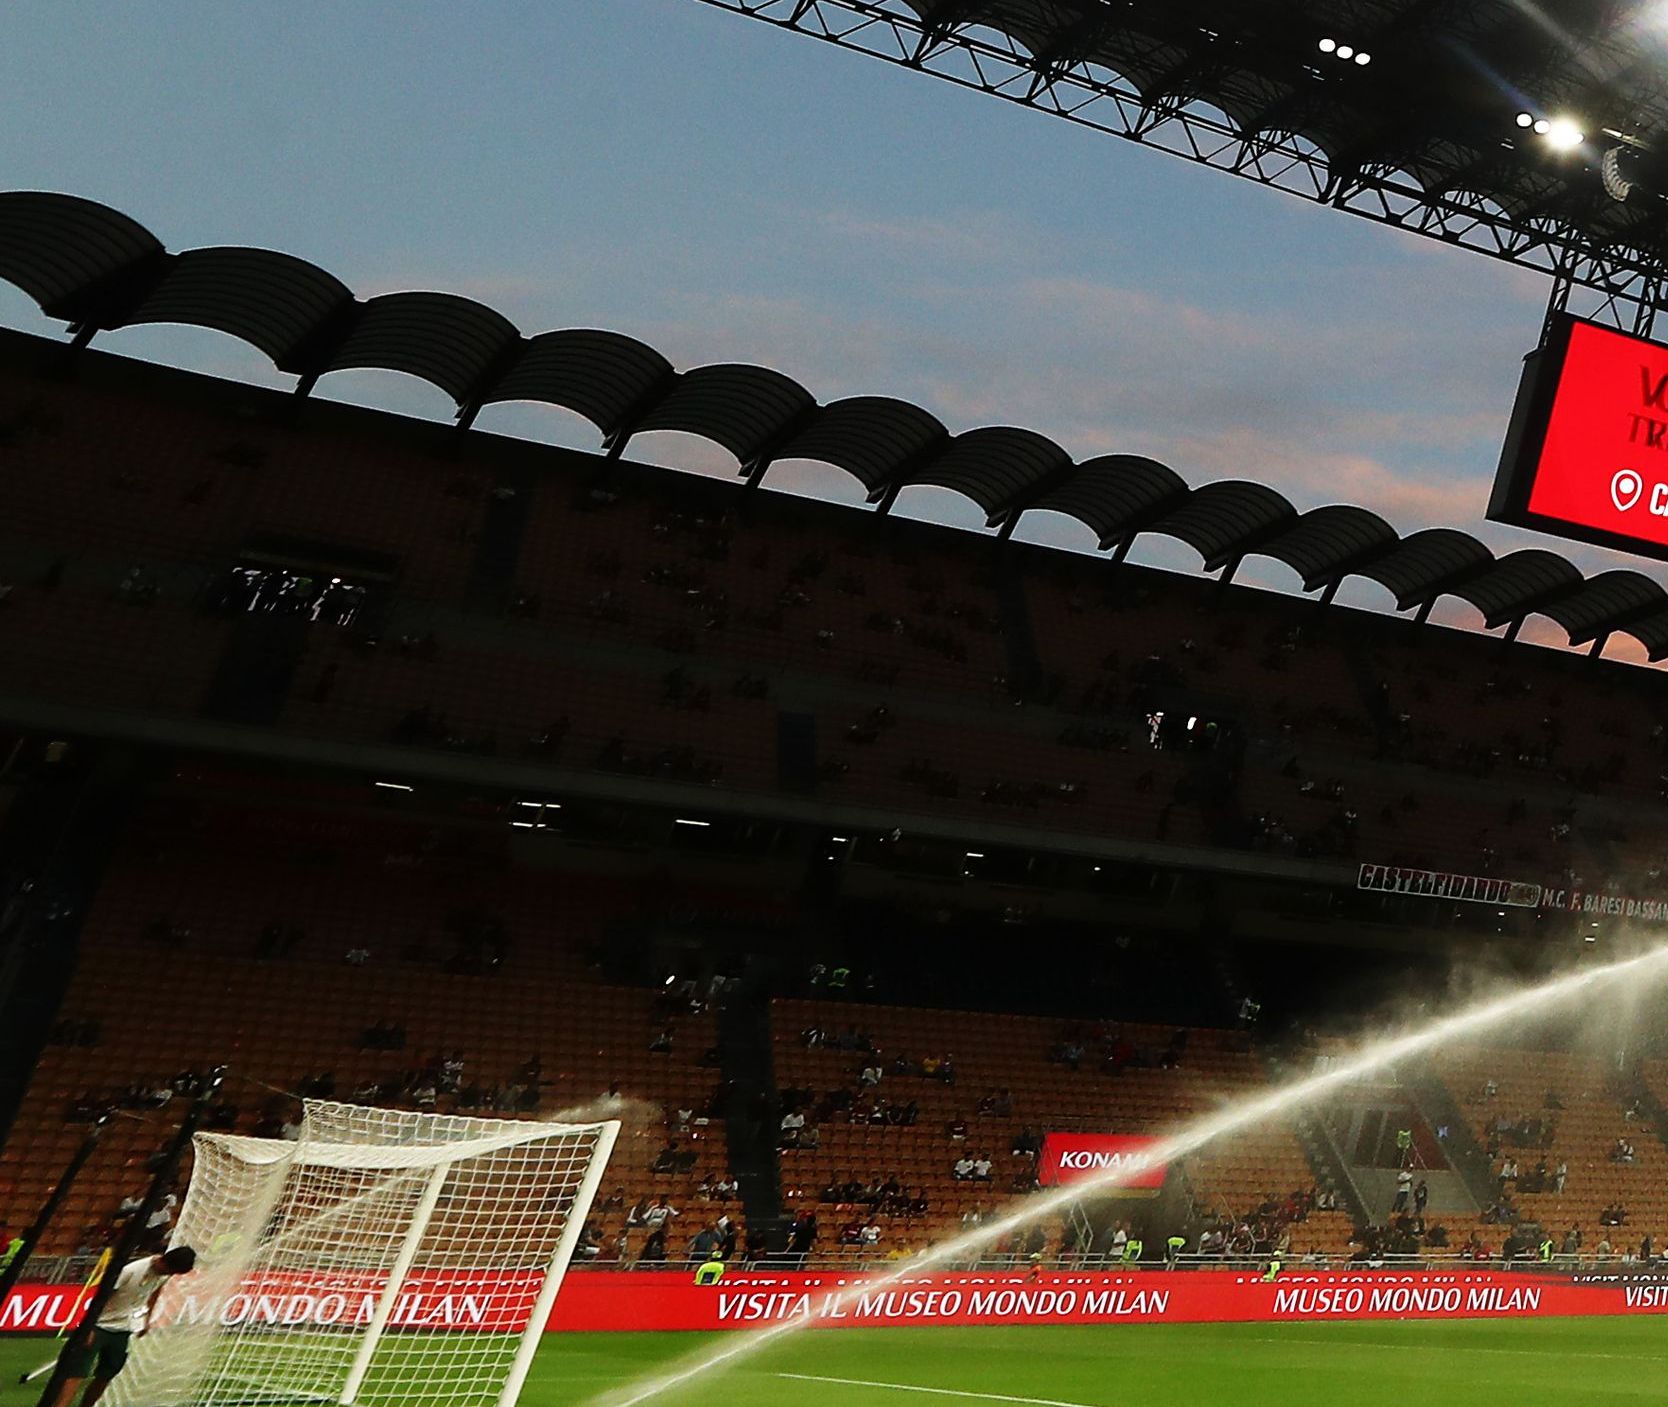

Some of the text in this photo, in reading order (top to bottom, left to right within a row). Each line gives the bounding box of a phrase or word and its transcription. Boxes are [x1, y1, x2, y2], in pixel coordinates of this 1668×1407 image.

[1584, 895, 1625, 915] BARESI
[718, 1290, 1169, 1320] VISITA IL MUSEO MONDO MILAN
[1273, 1287, 1541, 1313] MUSEO MONDO MILAN
